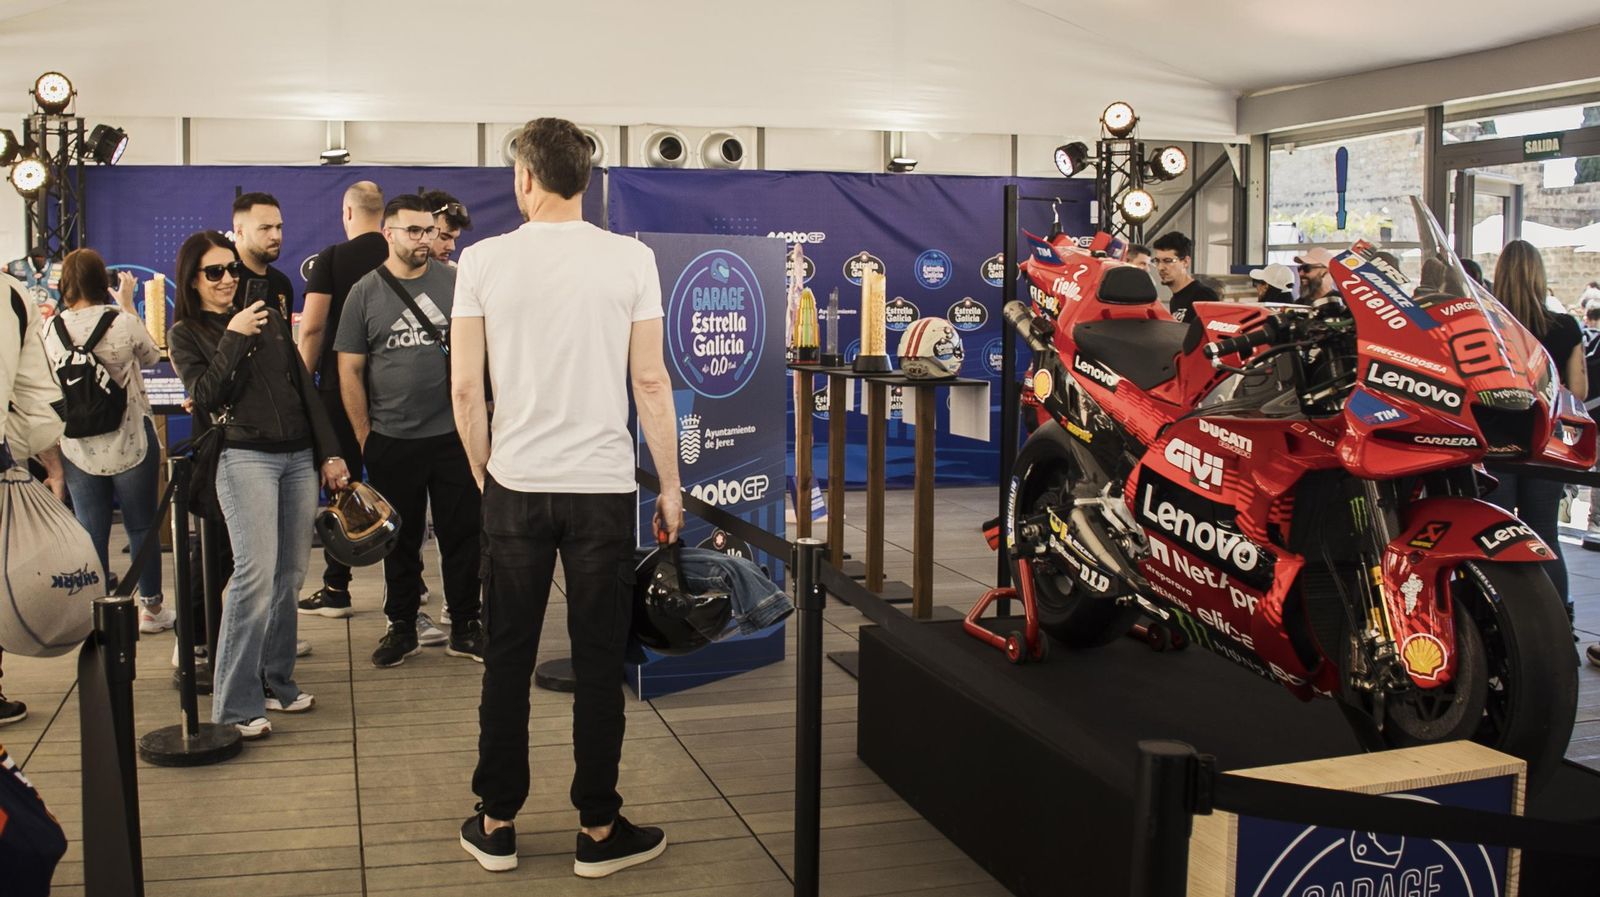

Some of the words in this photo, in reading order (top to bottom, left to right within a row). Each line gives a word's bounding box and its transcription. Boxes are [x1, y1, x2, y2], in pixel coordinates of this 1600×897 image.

[1525, 138, 1560, 154] SALIDA
[692, 287, 745, 311] GARAGE
[954, 306, 982, 316] Estrella
[691, 312, 748, 334] Estrella
[692, 334, 745, 357] Galicia
[1366, 344, 1448, 373] FRECCIAROSSA
[1074, 354, 1116, 387] Lenovo
[1367, 363, 1461, 408] Lenovo
[1374, 408, 1400, 421] TIM
[705, 425, 757, 439] Ayuntamiento
[1199, 418, 1253, 453] DUCATI
[1308, 431, 1335, 447] Aud
[1414, 435, 1478, 447] CARRERA
[705, 439, 715, 449] de
[715, 438, 735, 451] Jerez
[1164, 437, 1224, 487] GIVI
[681, 474, 769, 507] otoGP
[1143, 483, 1258, 571] Lenovo
[1480, 525, 1532, 549] Leno
[51, 568, 100, 590] SHARK
